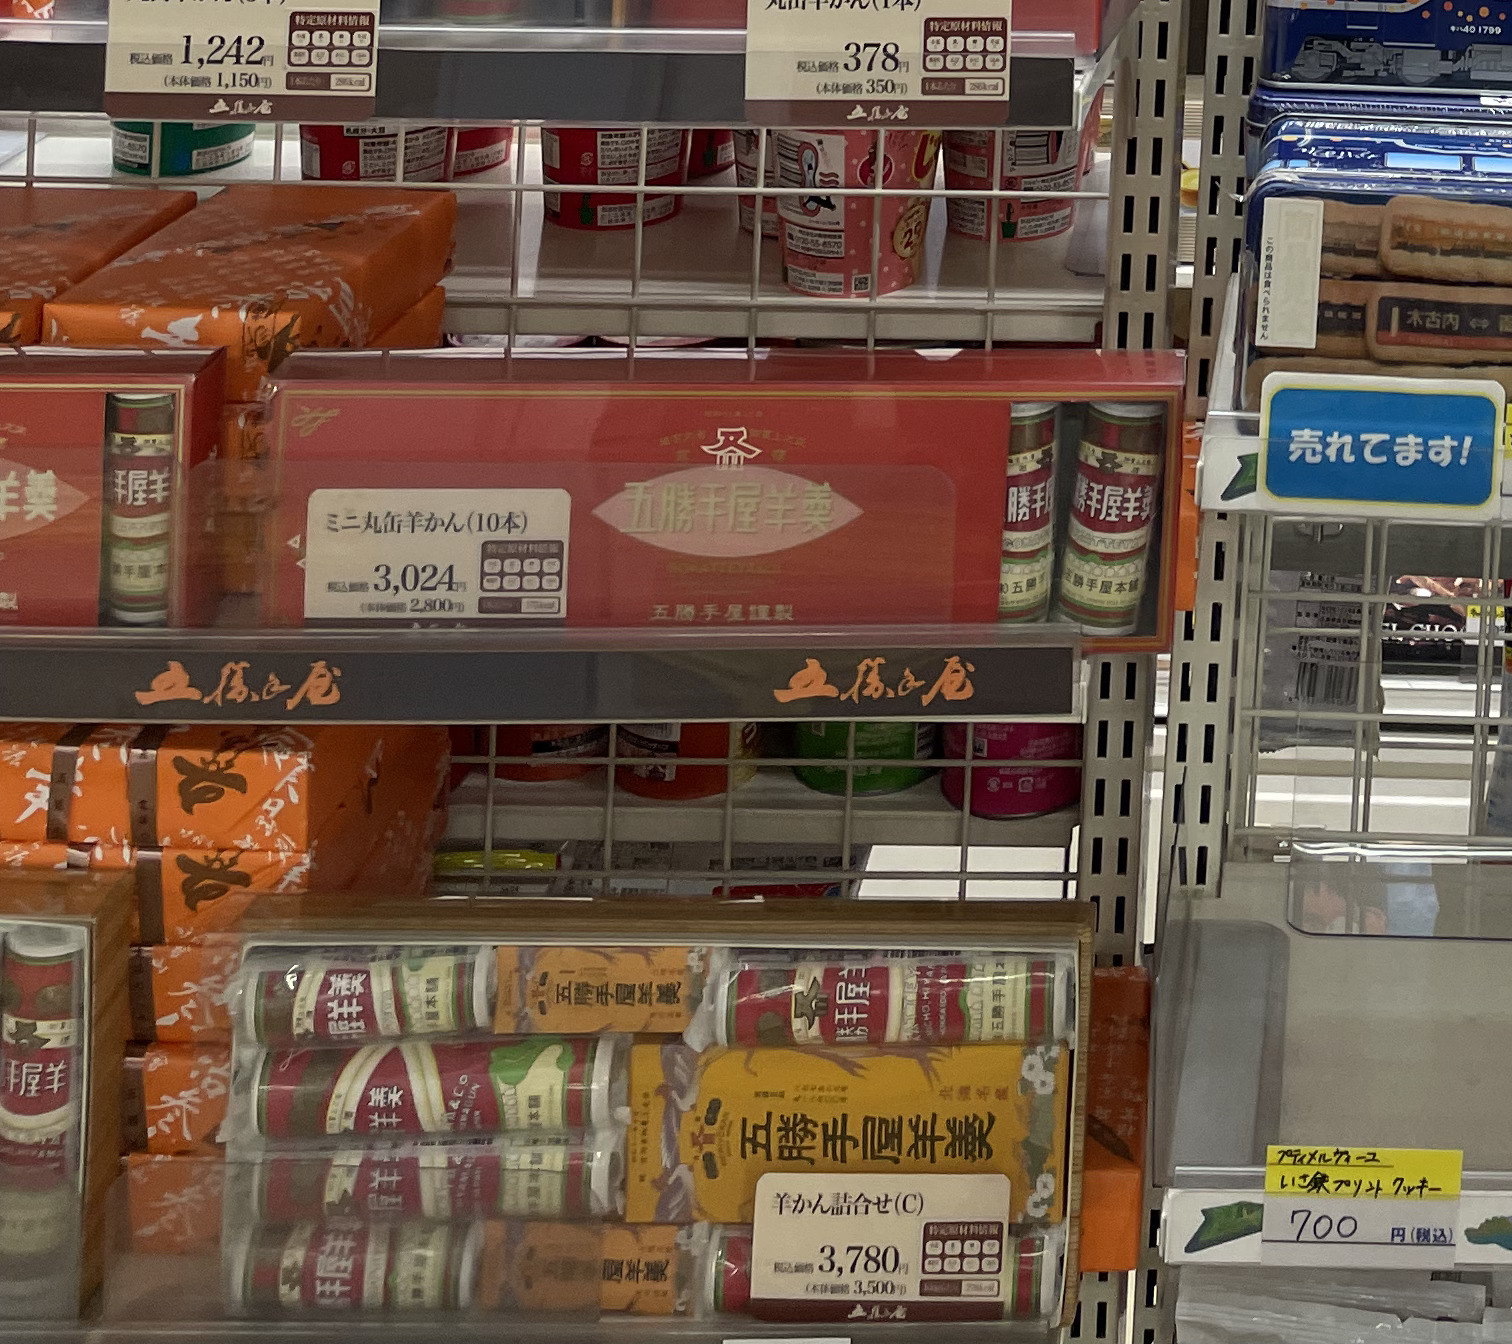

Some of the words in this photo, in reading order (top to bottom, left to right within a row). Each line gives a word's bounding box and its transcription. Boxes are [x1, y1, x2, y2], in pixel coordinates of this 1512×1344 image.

[130, 53, 173, 65] 税込価格
[797, 60, 839, 73] 税込価格
[1406, 310, 1460, 332] 木古内
[624, 481, 834, 535] 五勝手屋羊羹
[325, 510, 528, 536] ミニ丸缶羊かん(10本)
[740, 1111, 996, 1166] 五勝手屋羊羹
[773, 1192, 924, 1217] 羊かん詰合せ(C)
[1290, 1209, 1358, 1242] 700
